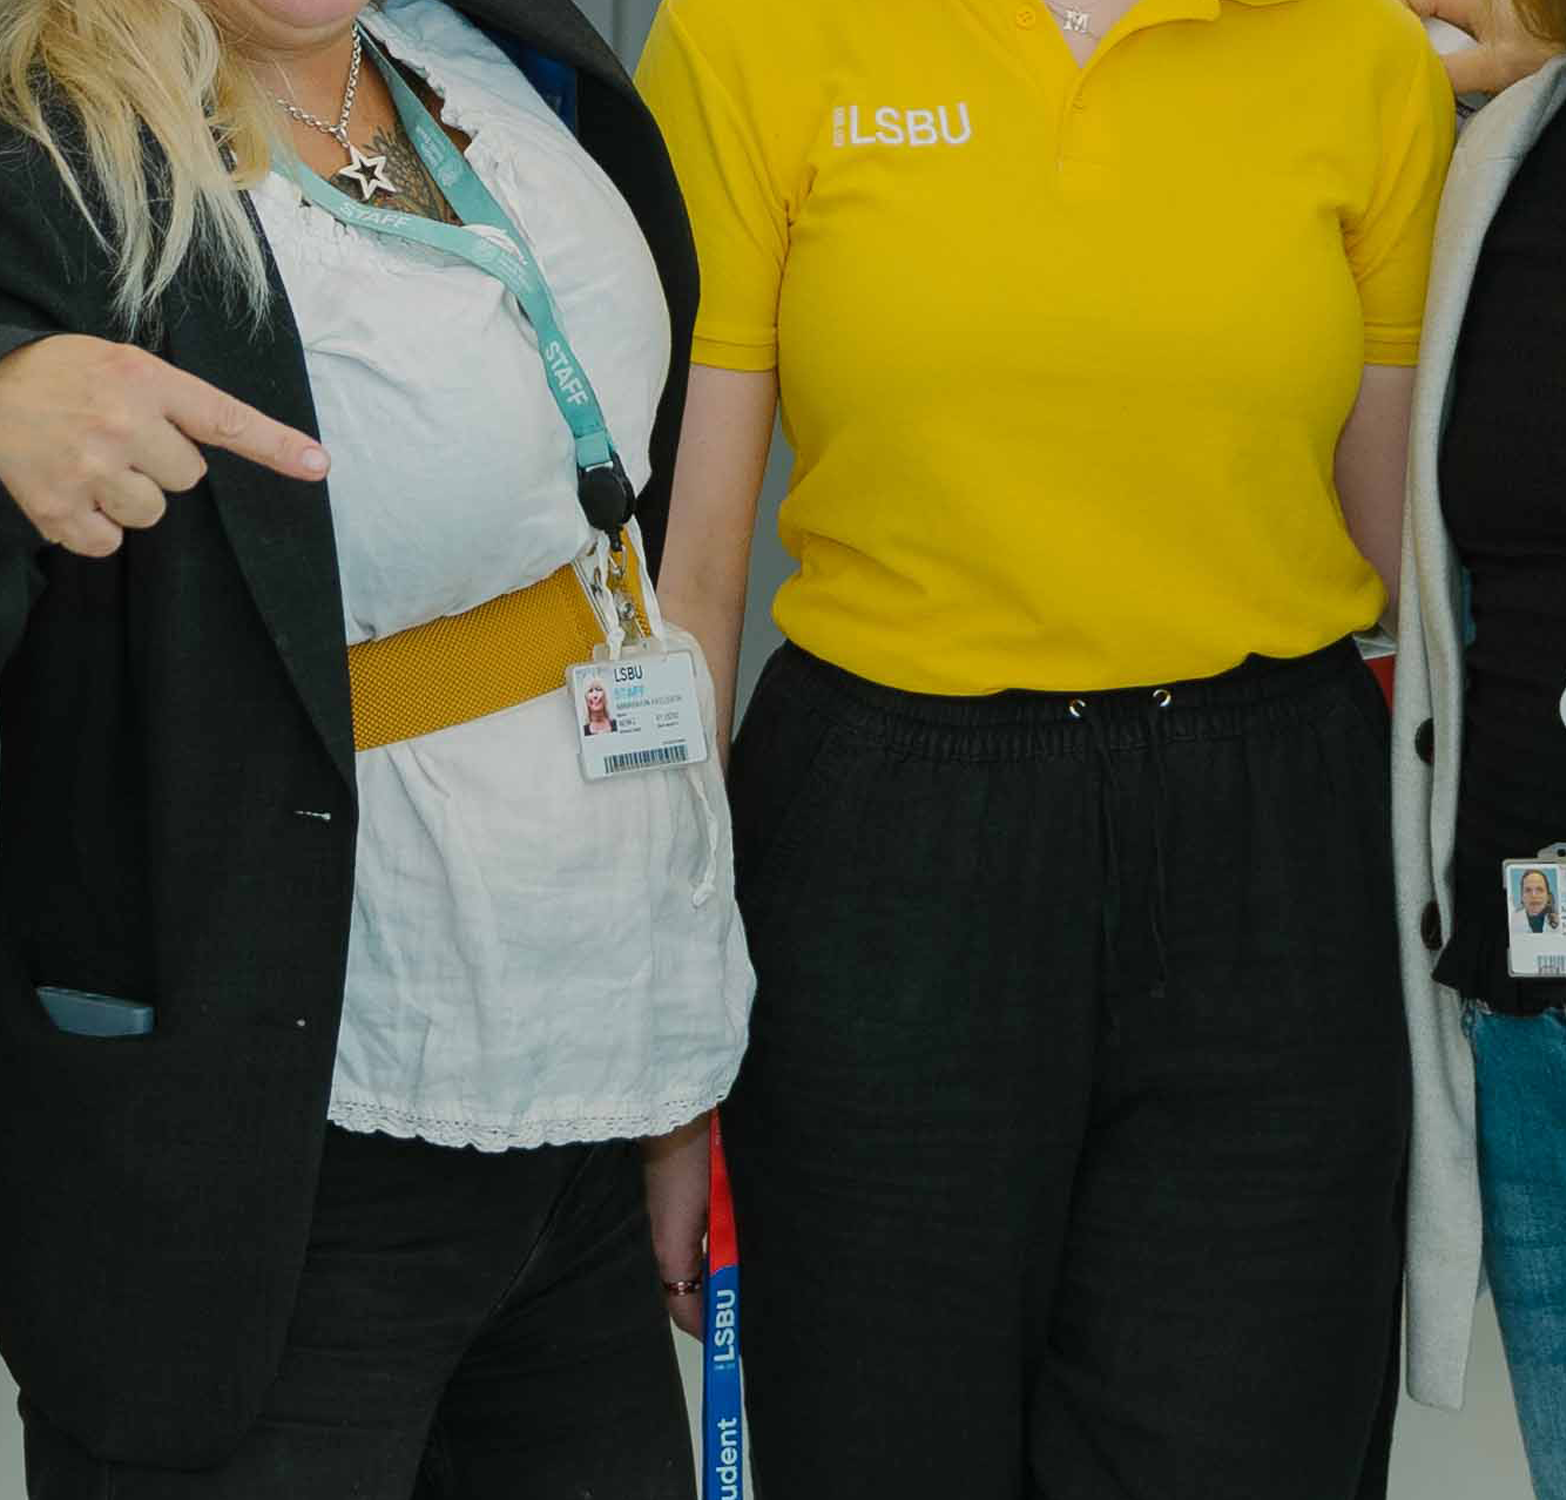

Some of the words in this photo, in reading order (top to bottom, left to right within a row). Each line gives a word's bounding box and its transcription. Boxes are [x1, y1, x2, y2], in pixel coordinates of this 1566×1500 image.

[849, 101, 972, 146] LSBU
[338, 201, 412, 229] STAFF
[544, 340, 589, 407] STAFF
[614, 665, 643, 682] LSBU
[714, 1288, 736, 1363] LSBU
[715, 1417, 738, 1500] udent
